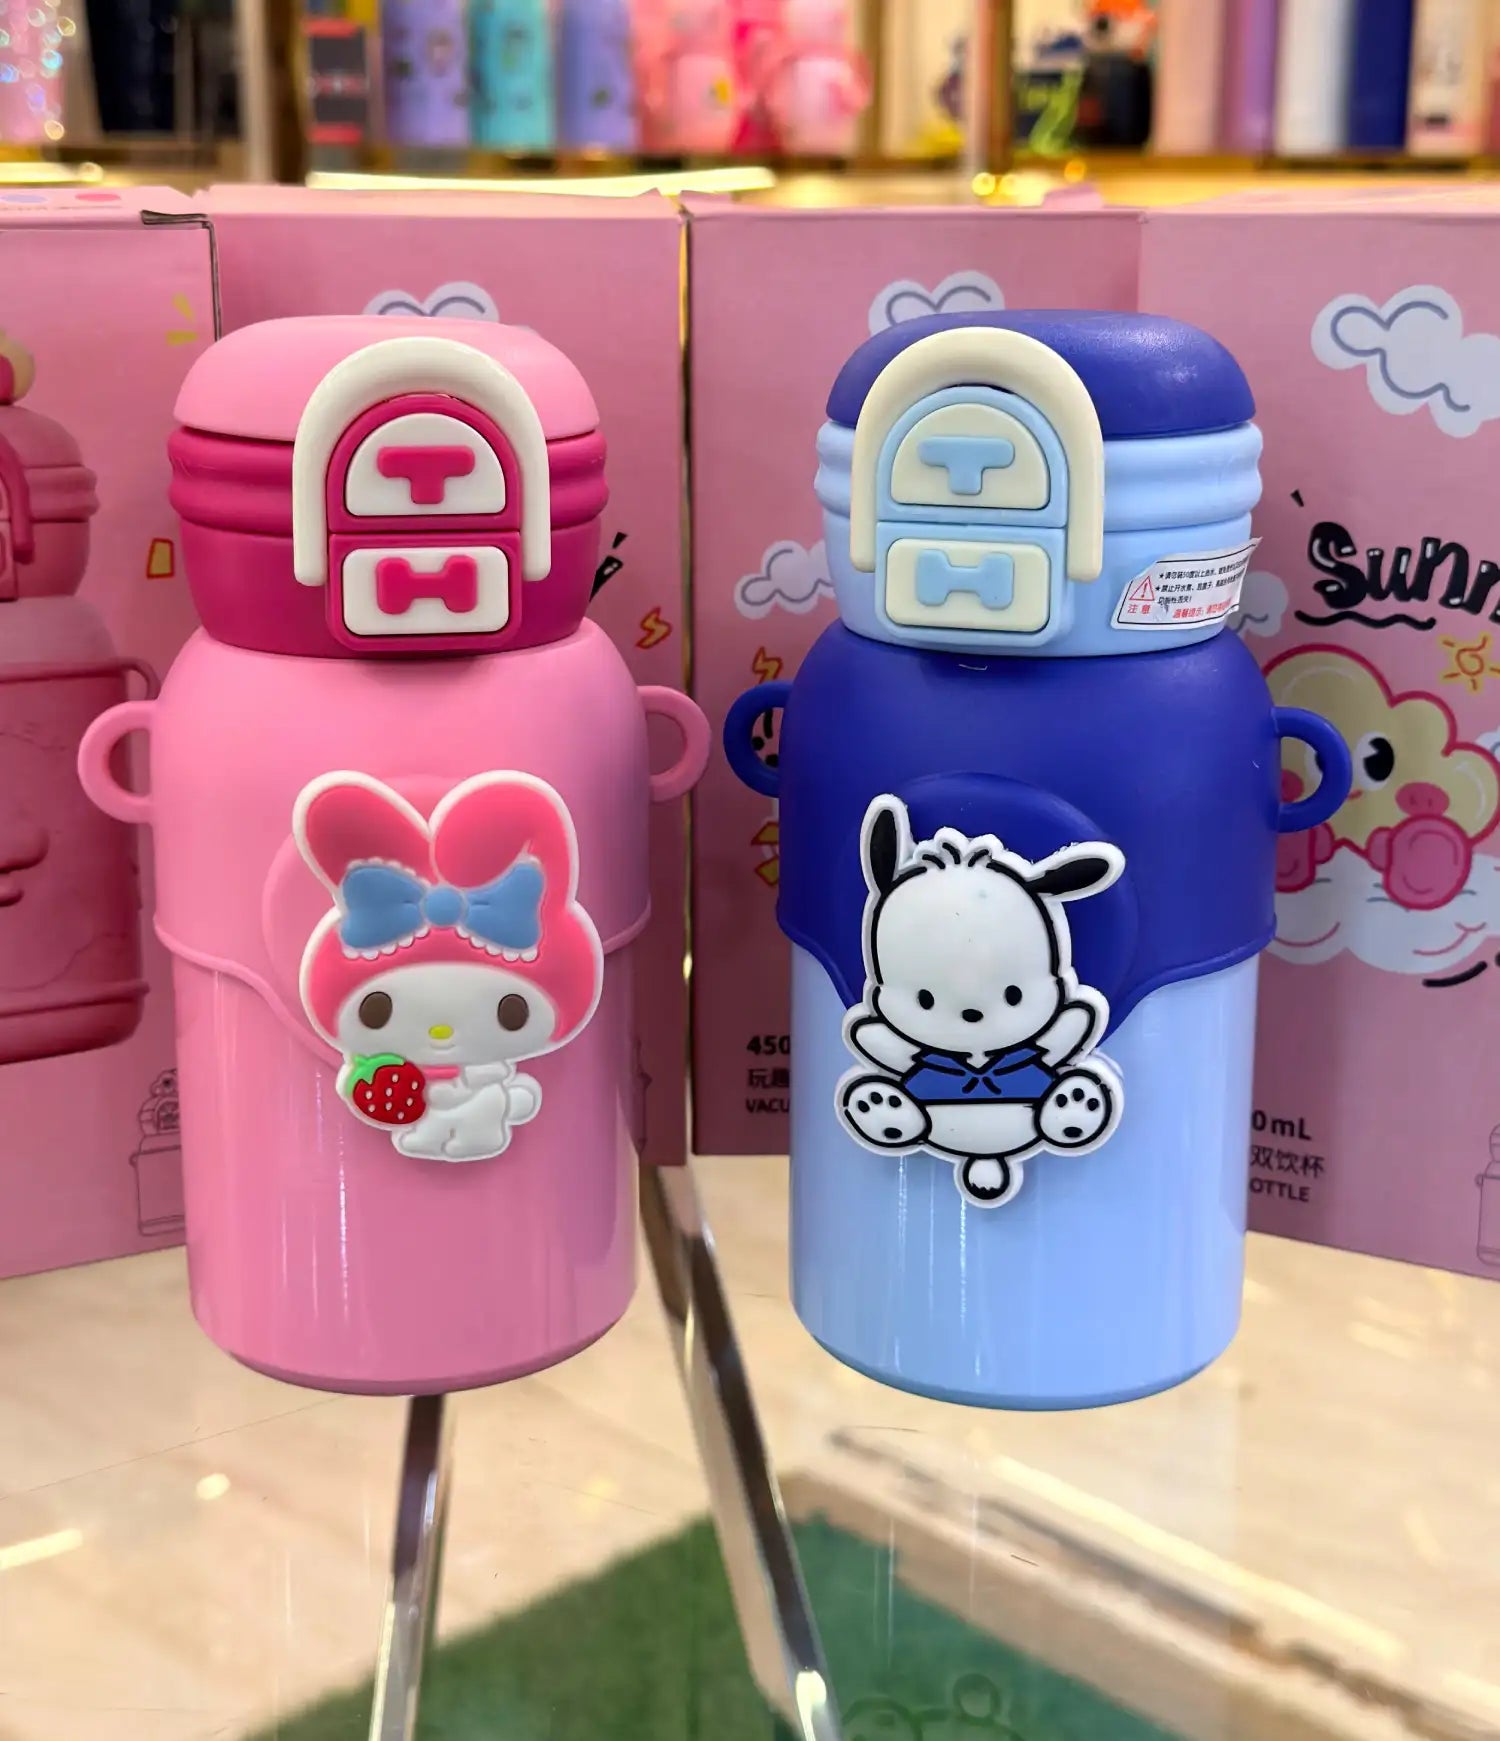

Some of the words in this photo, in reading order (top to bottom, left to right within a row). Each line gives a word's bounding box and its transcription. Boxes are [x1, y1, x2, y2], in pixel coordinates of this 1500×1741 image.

[1127, 604, 1151, 615] 注意
[746, 1035, 790, 1056] 450
[1250, 1145, 1326, 1179] 双饮杯
[1249, 1177, 1311, 1203] OTTLE
